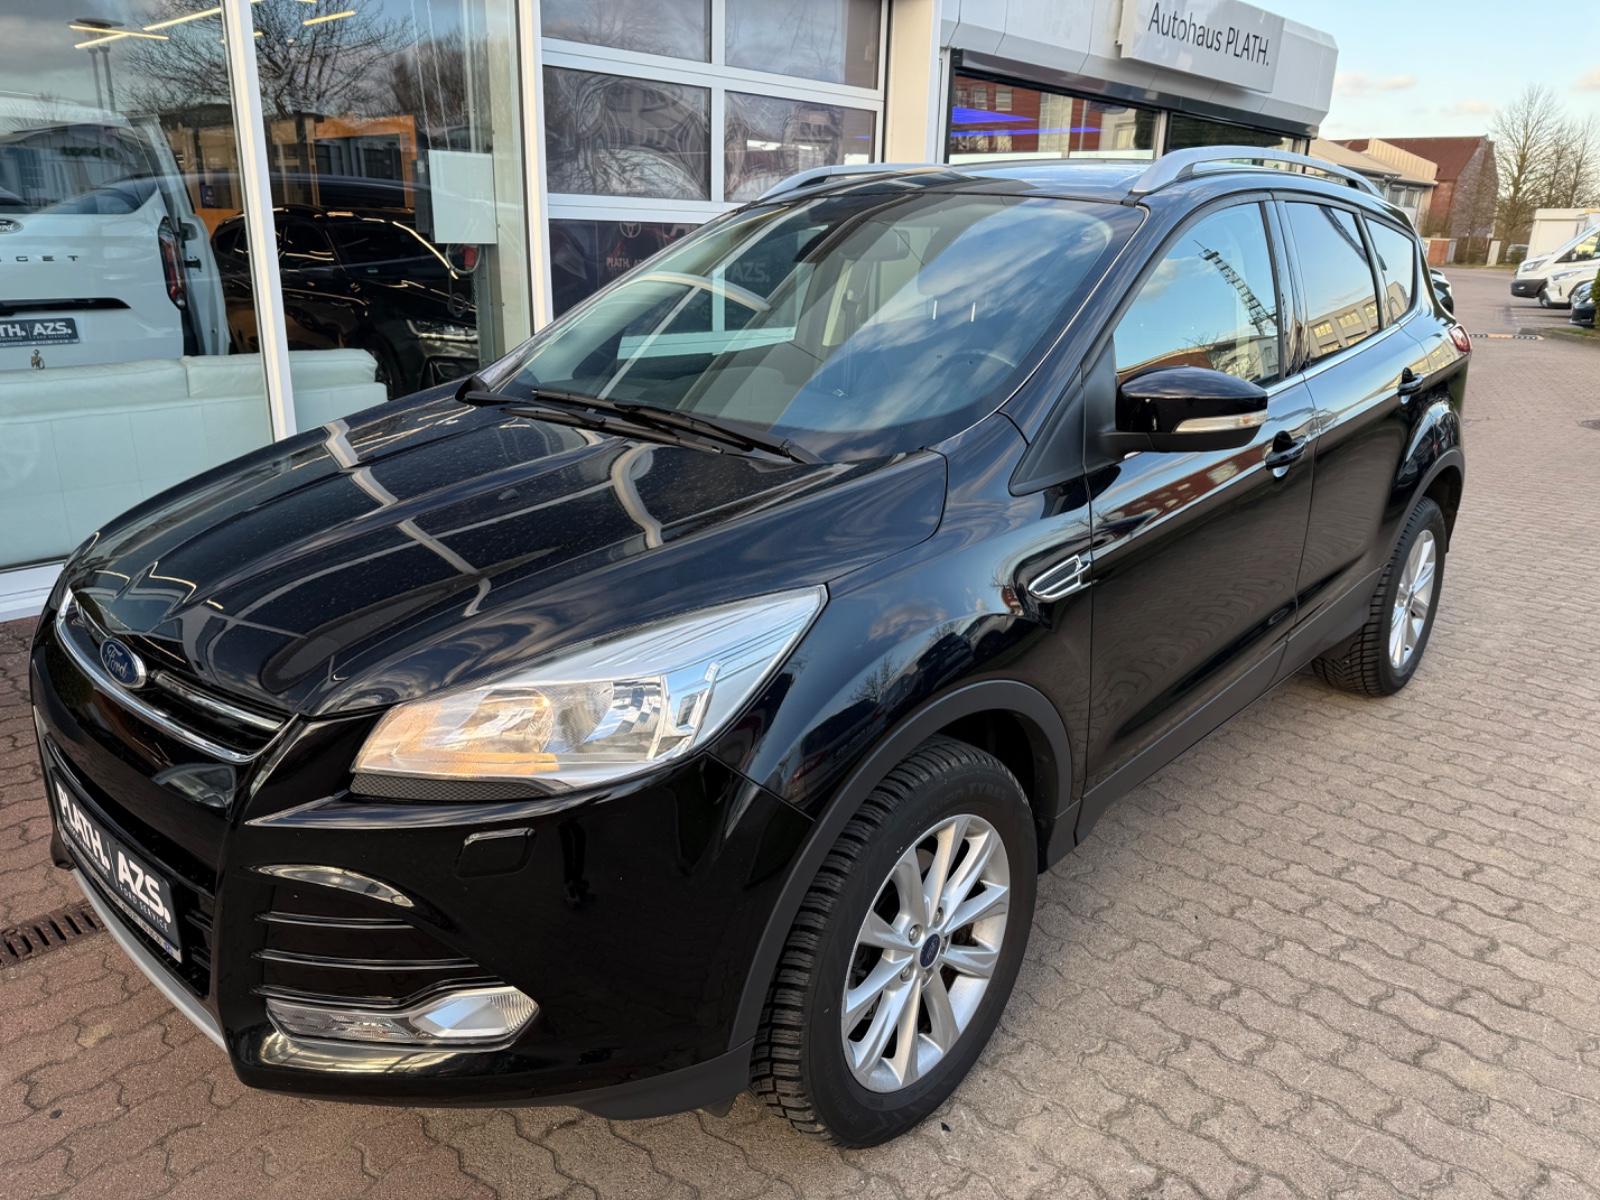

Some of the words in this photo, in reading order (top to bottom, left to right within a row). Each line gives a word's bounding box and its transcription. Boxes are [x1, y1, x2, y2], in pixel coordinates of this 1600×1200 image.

[1148, 2, 1223, 52] Autohaus
[1225, 26, 1270, 67] PLATH.
[0, 254, 79, 263] GET
[33, 322, 73, 336] AZS.
[104, 642, 130, 681] Ford
[55, 780, 111, 871] PLATH.
[117, 850, 172, 924] AZS.
